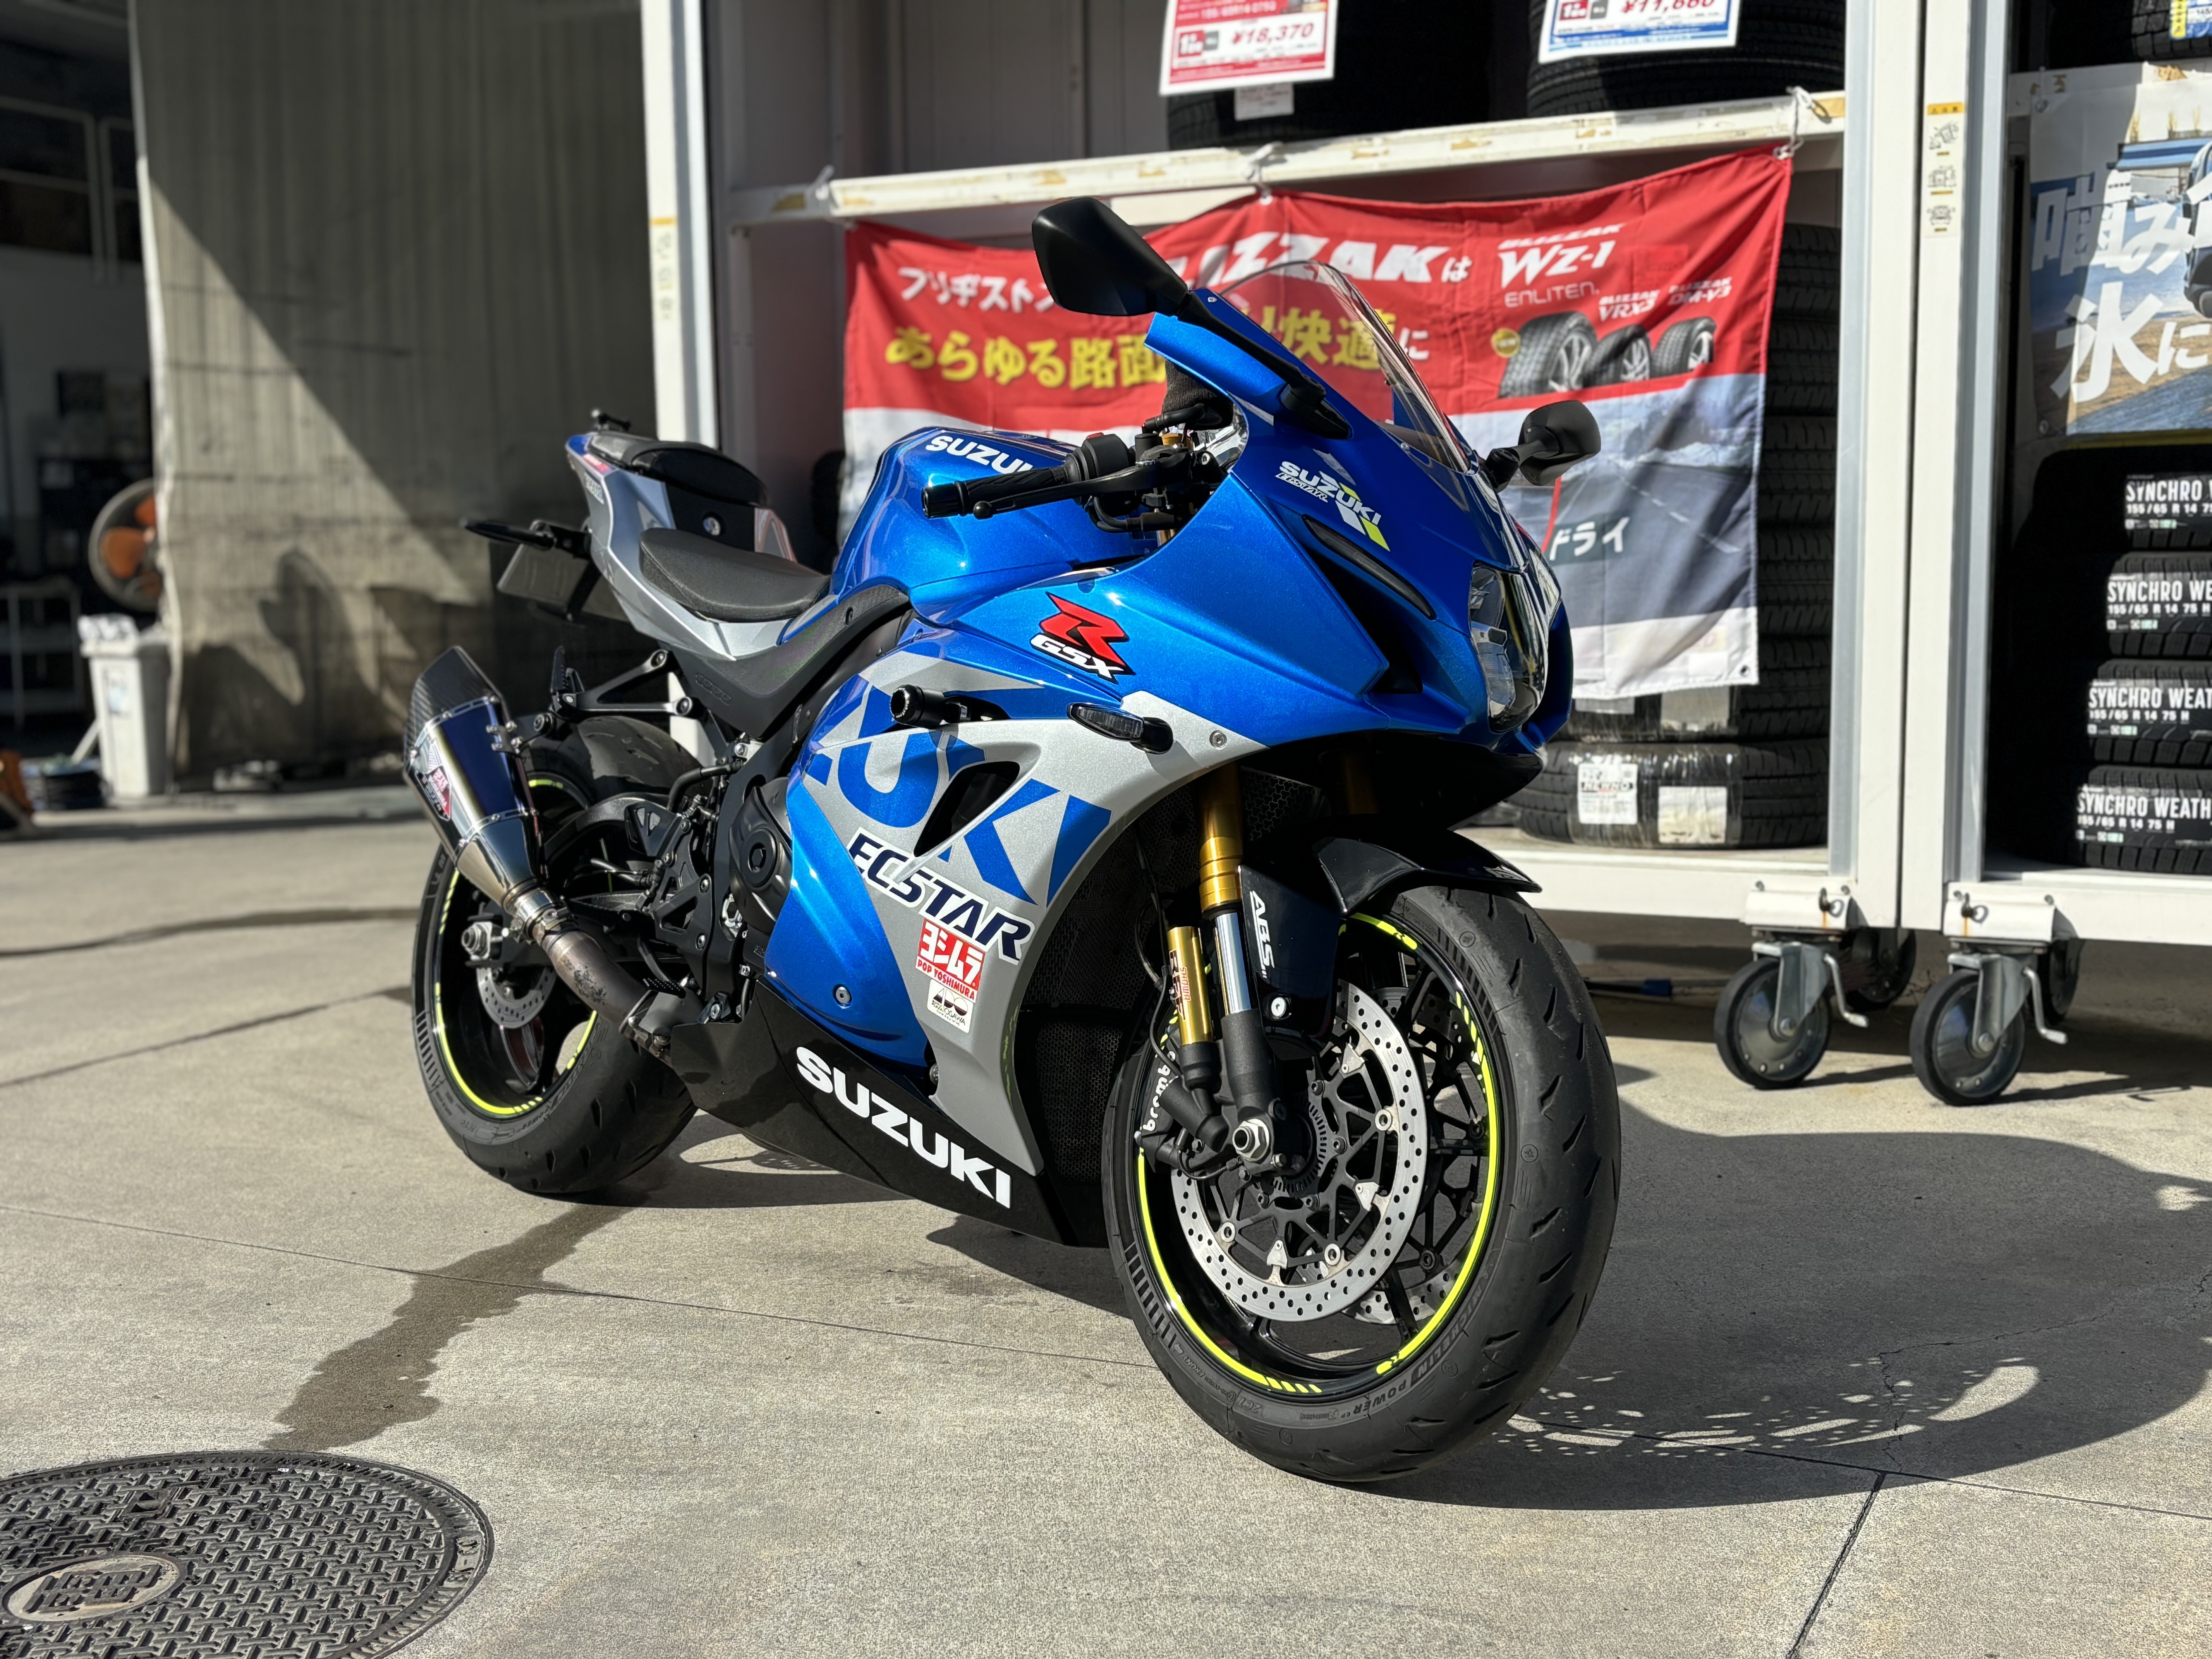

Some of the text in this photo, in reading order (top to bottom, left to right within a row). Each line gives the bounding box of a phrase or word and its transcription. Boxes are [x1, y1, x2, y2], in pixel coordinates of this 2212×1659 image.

[1233, 23, 1314, 45] ¥18,370
[1498, 239, 1617, 289] WZ-1
[1599, 298, 1656, 322] VRX3
[1667, 285, 1732, 306] DM-V3
[926, 436, 1033, 474] SUZU
[1275, 472, 1328, 503] ECSTAR
[1279, 461, 1381, 525] SUZUKI
[2126, 480, 2203, 502] SYNCHRO
[1550, 517, 1630, 561] ドライ
[2107, 581, 2183, 603] SYNCHRO
[1029, 633, 1124, 679] GSX
[2088, 688, 2162, 709] SYNCHRO
[2077, 793, 2148, 817] SYNCHRO
[849, 833, 1032, 962] ECSTAR
[1250, 891, 1274, 969] ABS
[919, 921, 984, 986] ヨシムラ
[918, 959, 975, 1000] POP YOSHIMURA
[1180, 967, 1191, 1001] SHOWA
[796, 1047, 1012, 1209] SUZUKI
[1183, 1356, 1205, 1377] FRONT
[1353, 1379, 1407, 1415] POWER
